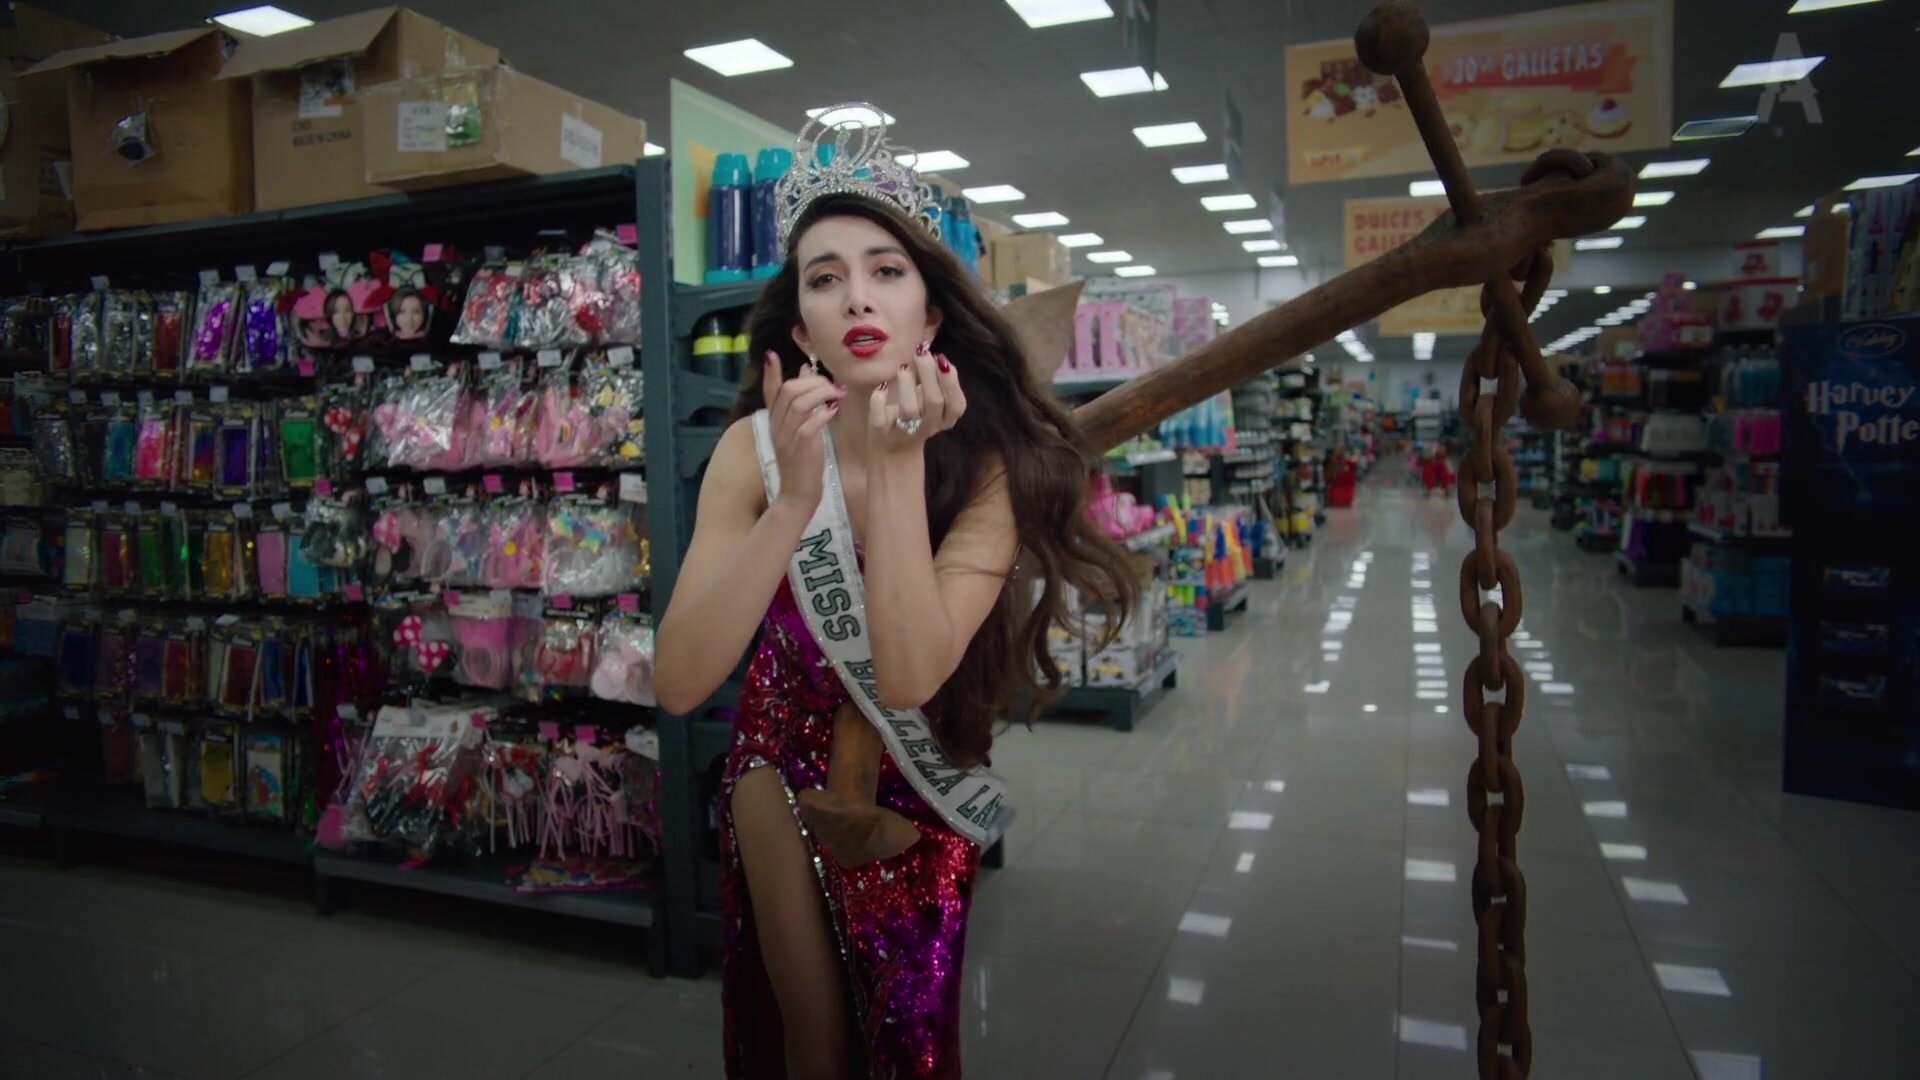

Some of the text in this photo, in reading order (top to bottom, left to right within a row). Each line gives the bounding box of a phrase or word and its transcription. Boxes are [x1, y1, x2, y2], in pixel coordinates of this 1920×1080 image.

[1502, 42, 1604, 81] GALLETAS
[292, 128, 352, 147] MADE IN CHINA
[1806, 379, 1916, 415] Harvey
[798, 528, 861, 642] MISS
[956, 783, 1004, 831] LA
